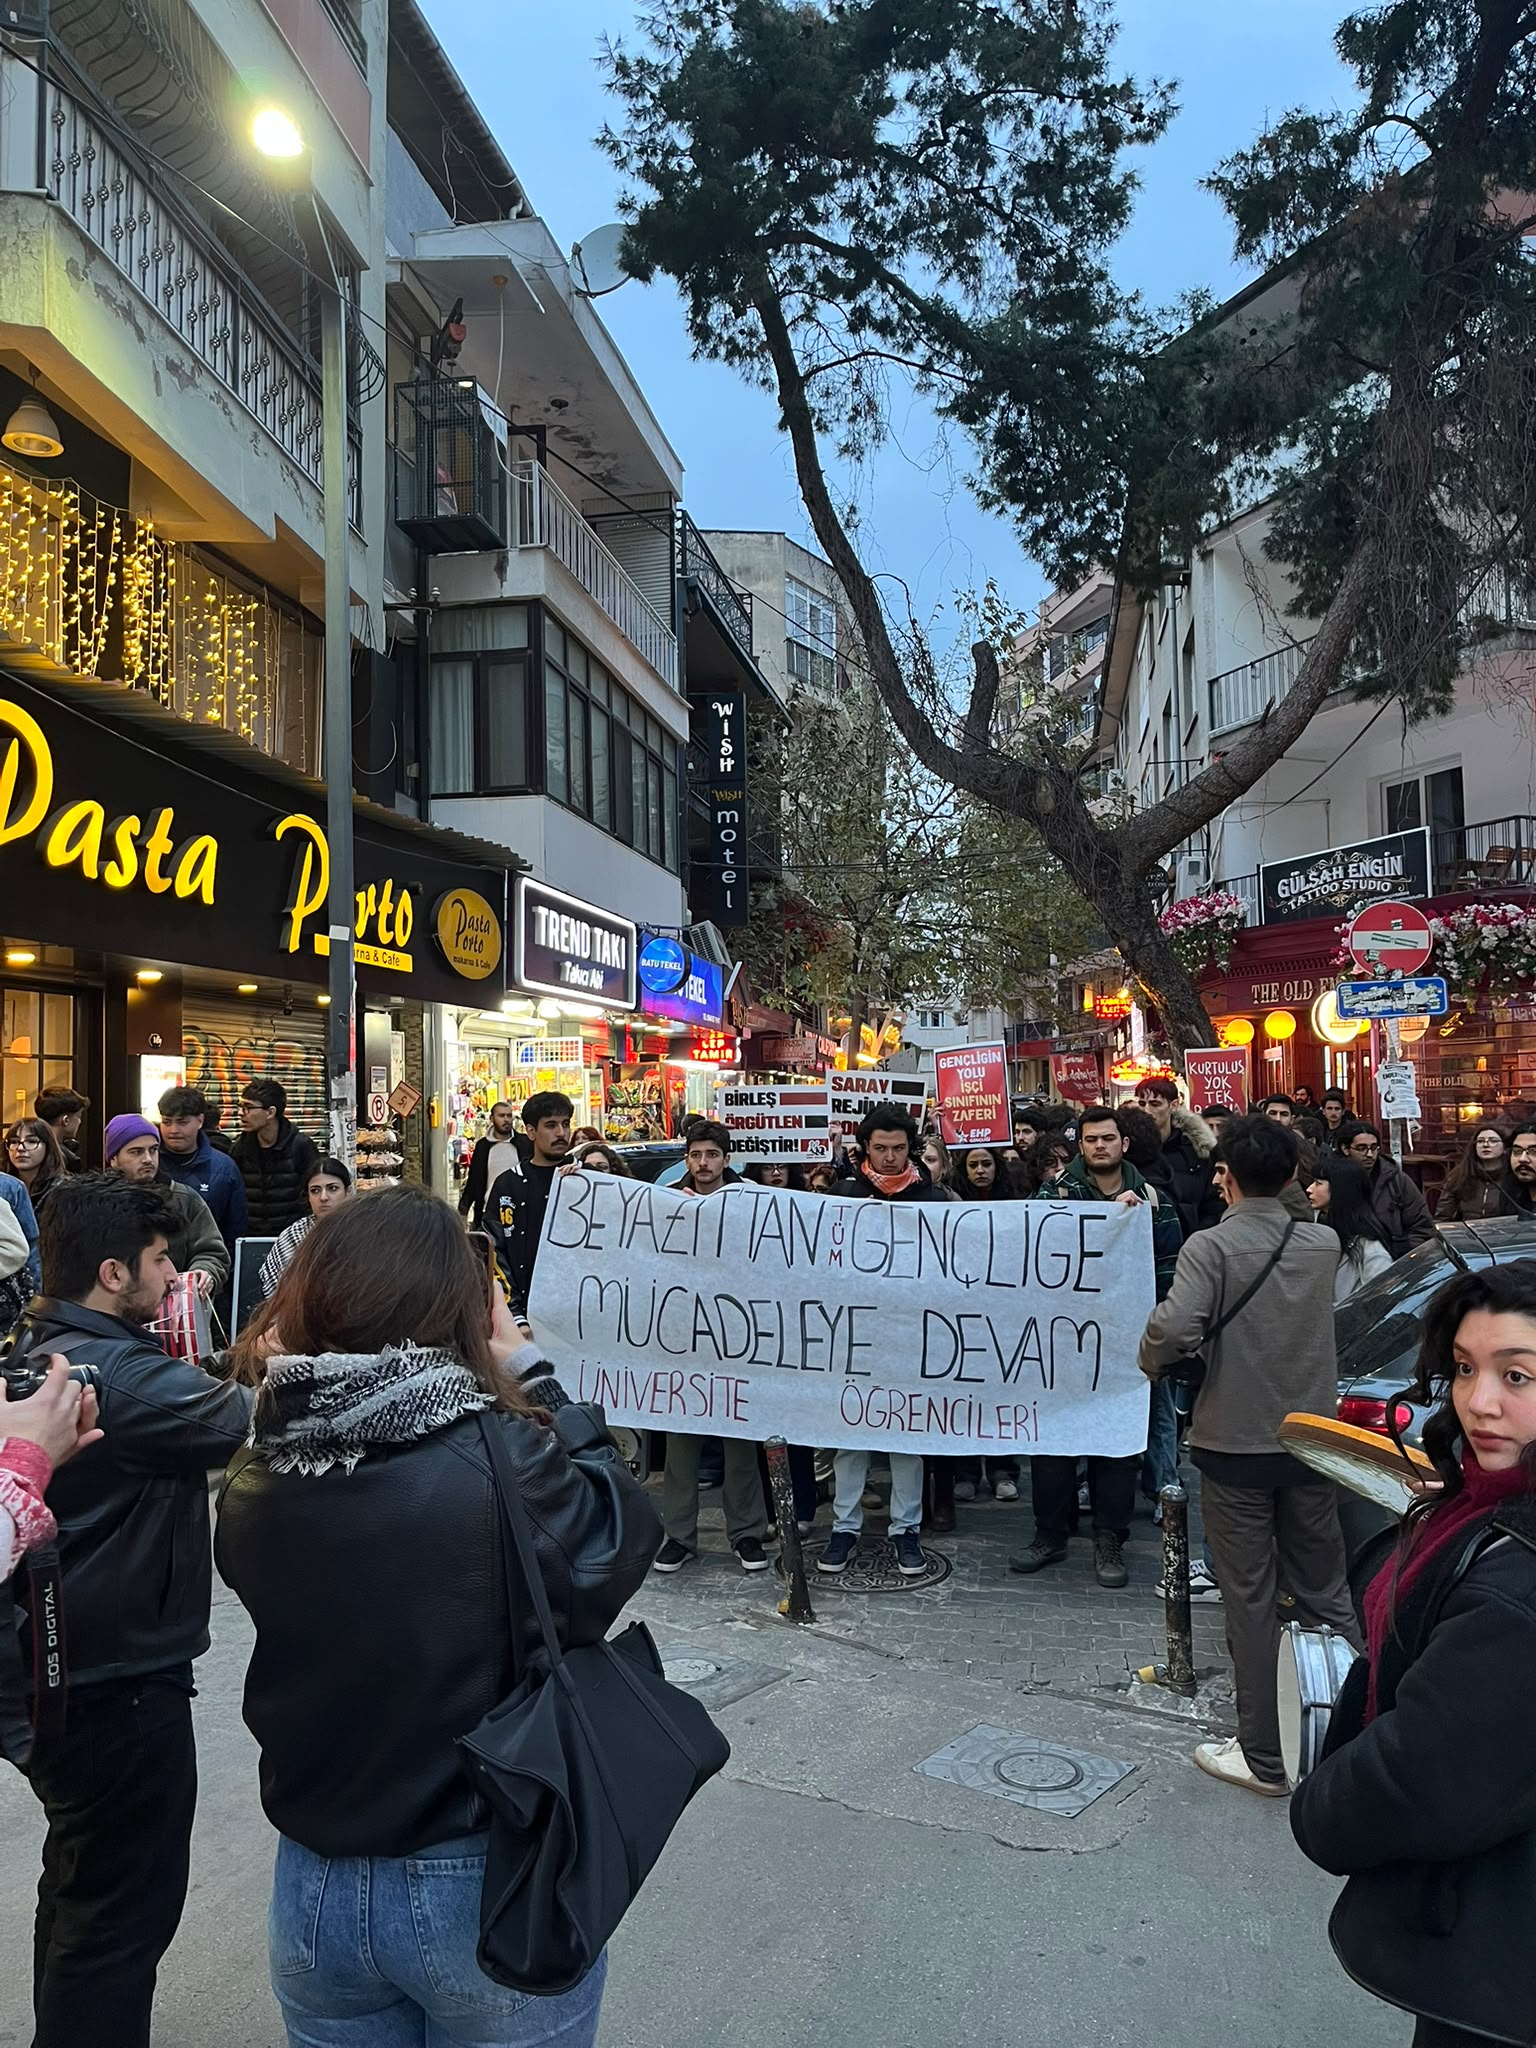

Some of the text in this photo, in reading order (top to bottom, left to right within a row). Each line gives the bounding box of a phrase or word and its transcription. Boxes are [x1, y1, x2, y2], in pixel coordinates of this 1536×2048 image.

[717, 809, 740, 908] motel
[1347, 851, 1404, 878] ENGİN
[275, 814, 413, 953] Prto
[1287, 879, 1392, 911] TATTOO STUDIO
[533, 905, 626, 971] TREND TAKI
[381, 951, 400, 967] Cafe
[641, 958, 682, 971] BATU TEKEL
[1251, 982, 1280, 1005] THE
[1283, 979, 1314, 1002] OLD
[957, 1066, 986, 1080] YOLU
[1204, 1075, 1232, 1090] YOK
[1423, 1077, 1442, 1088] THE
[1443, 1075, 1464, 1087] OLD
[831, 1076, 889, 1095] SARAY
[960, 1078, 983, 1094] İŞÇİ
[724, 1089, 777, 1109] BİRLEŞ
[944, 1093, 1002, 1108] SINIFININ
[1203, 1089, 1234, 1104] TEK
[724, 1112, 803, 1130] ÖRGÜTLEN
[952, 1105, 997, 1122] ZAFERİ
[970, 1128, 992, 1138] EHP
[729, 1136, 799, 1156] DEĞİŞTİR!
[828, 1205, 852, 1269] TÜM
[850, 1203, 1108, 1293] GENÇLİĞE
[577, 1274, 1102, 1392] MÜCADELEYE DEVAM
[578, 1359, 1040, 1443] ÜNİVERSİTE ÖĞRENCİLERİ
[44, 1581, 60, 1688] EOS DIGITAL
